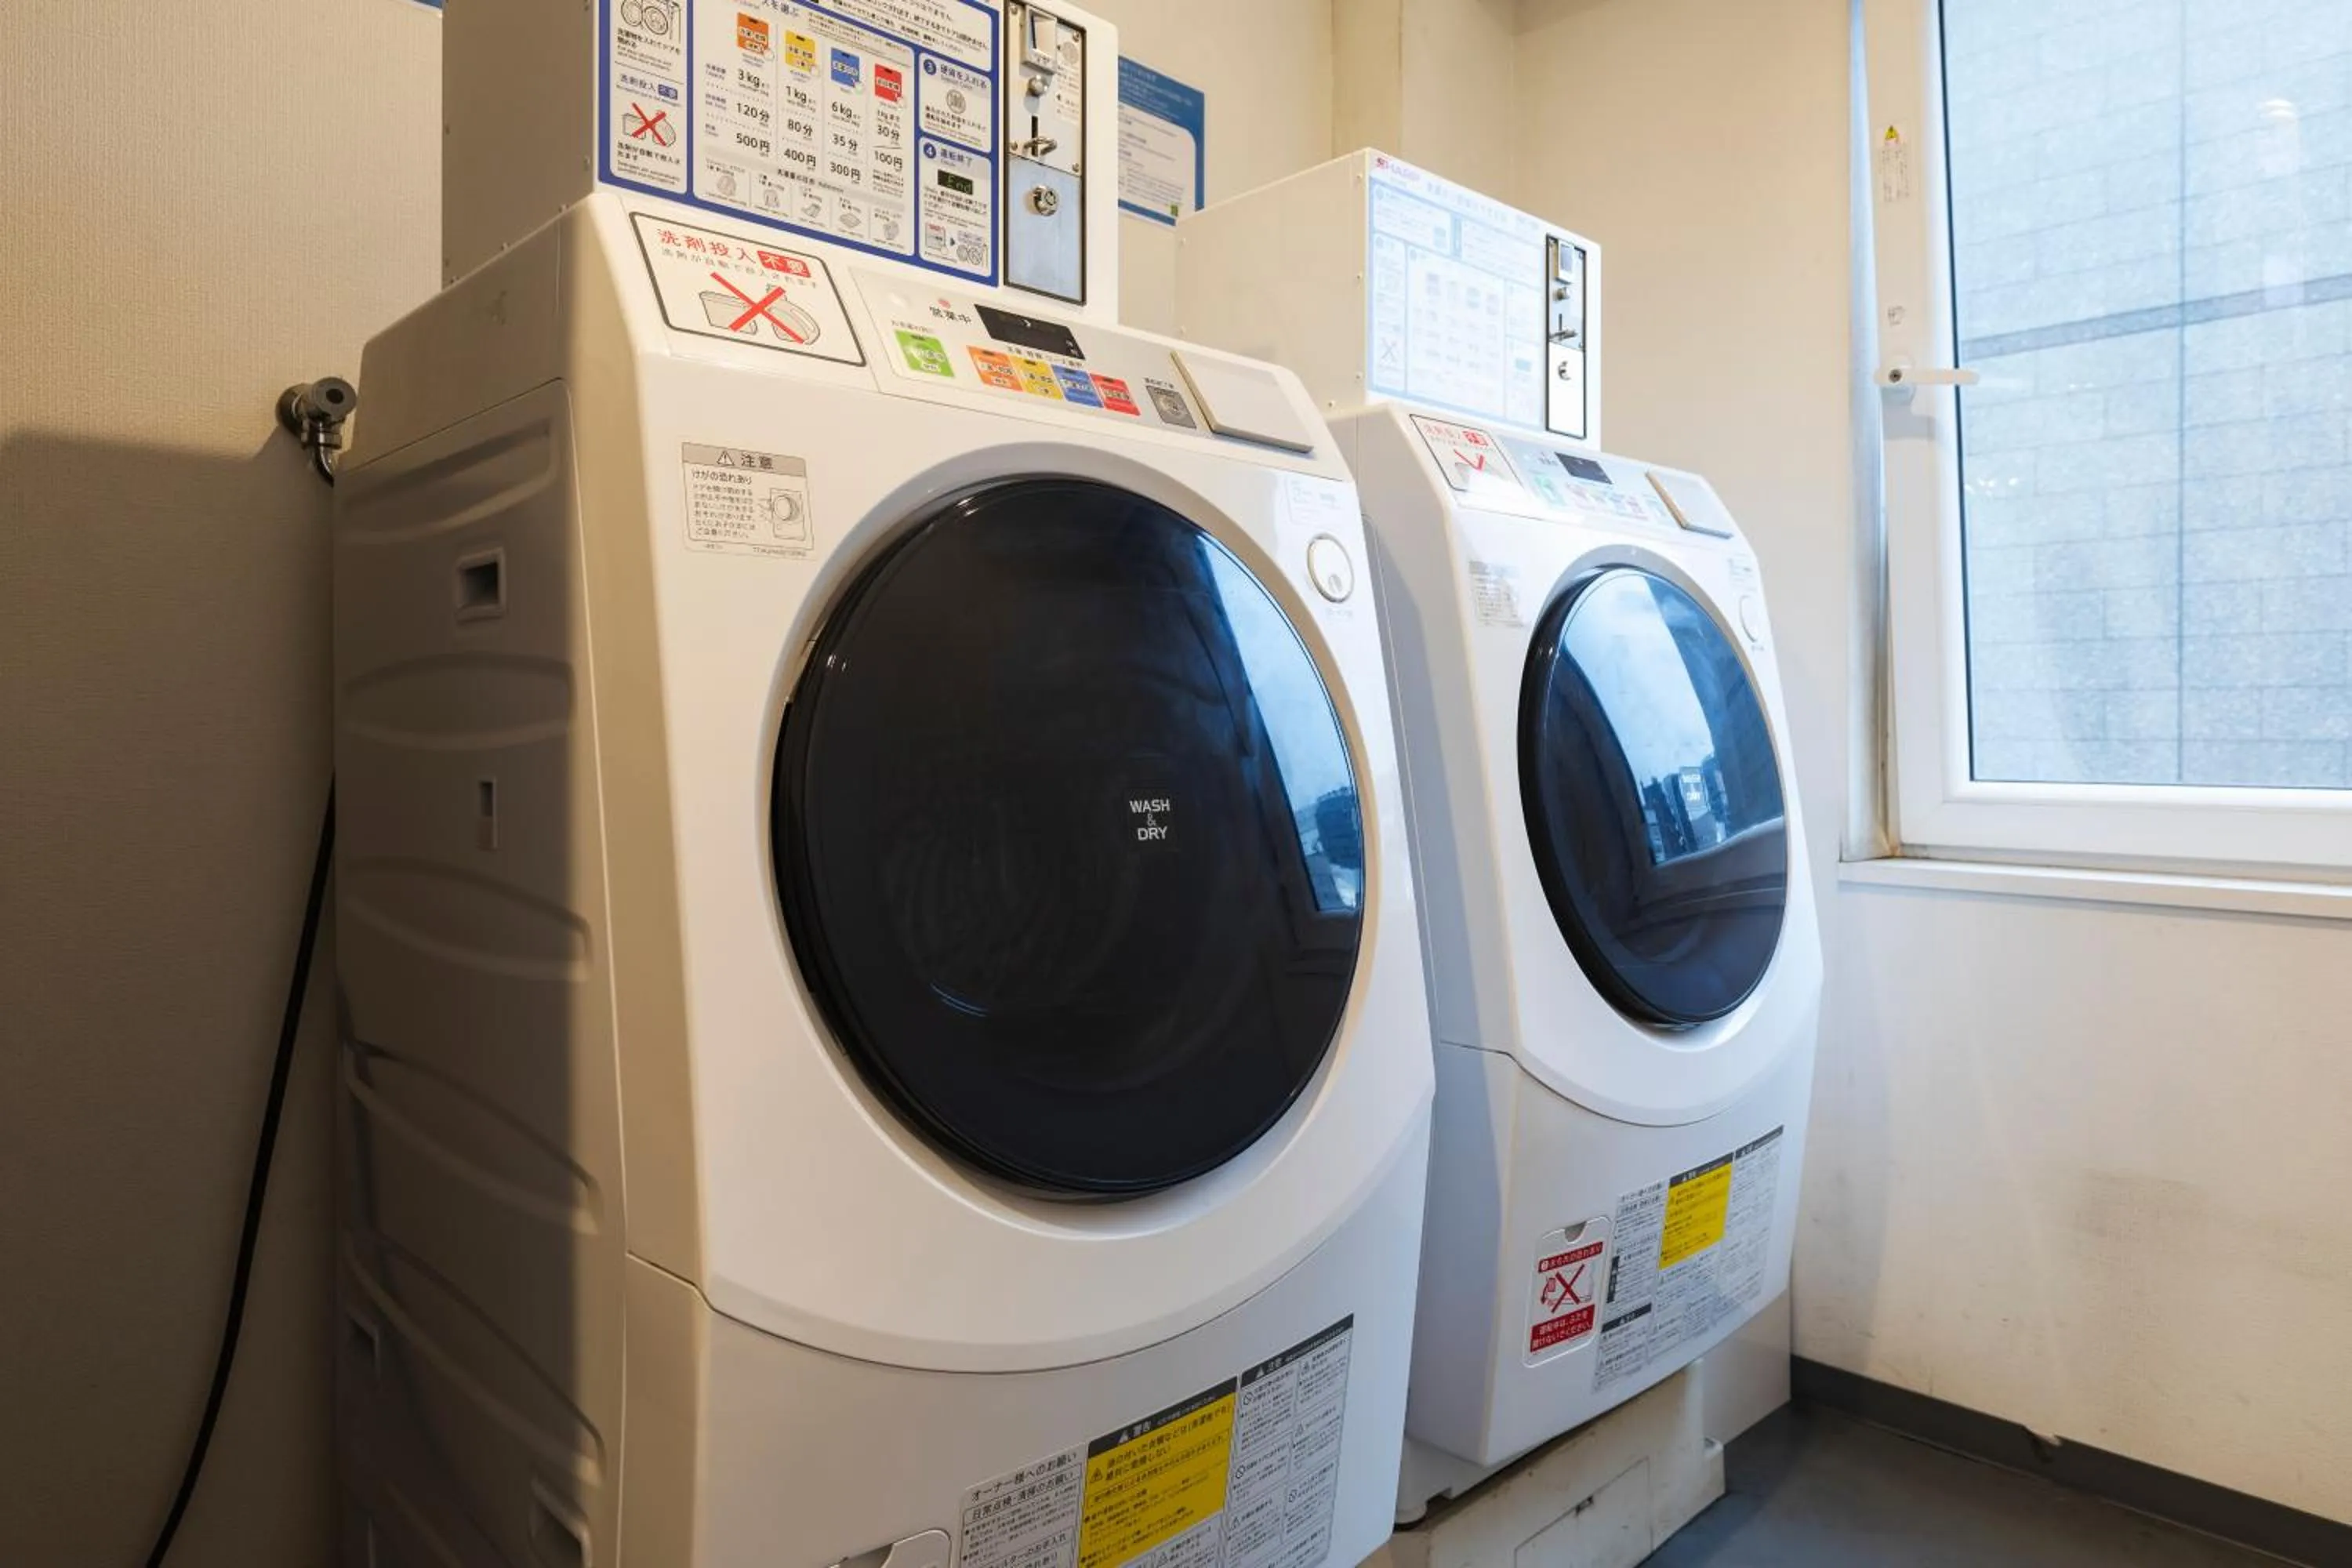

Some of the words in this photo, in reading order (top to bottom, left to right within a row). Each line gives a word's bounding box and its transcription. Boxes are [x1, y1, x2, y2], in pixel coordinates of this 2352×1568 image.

[736, 103, 770, 122] 120分
[788, 118, 812, 136] 80分
[877, 125, 899, 141] 30分
[736, 132, 770, 153] 500円
[833, 132, 857, 151] 35分
[784, 148, 816, 167] 400円
[875, 151, 902, 171] 100円
[830, 162, 860, 181] 300円
[657, 229, 756, 263] 洗剤投入
[741, 452, 774, 470] 注意
[691, 470, 752, 485] けがの恐れあり
[1129, 799, 1171, 813] WASH
[1147, 814, 1156, 826] &
[1138, 826, 1168, 840] DRY
[972, 1452, 1077, 1504] オーナー様へのお願い
